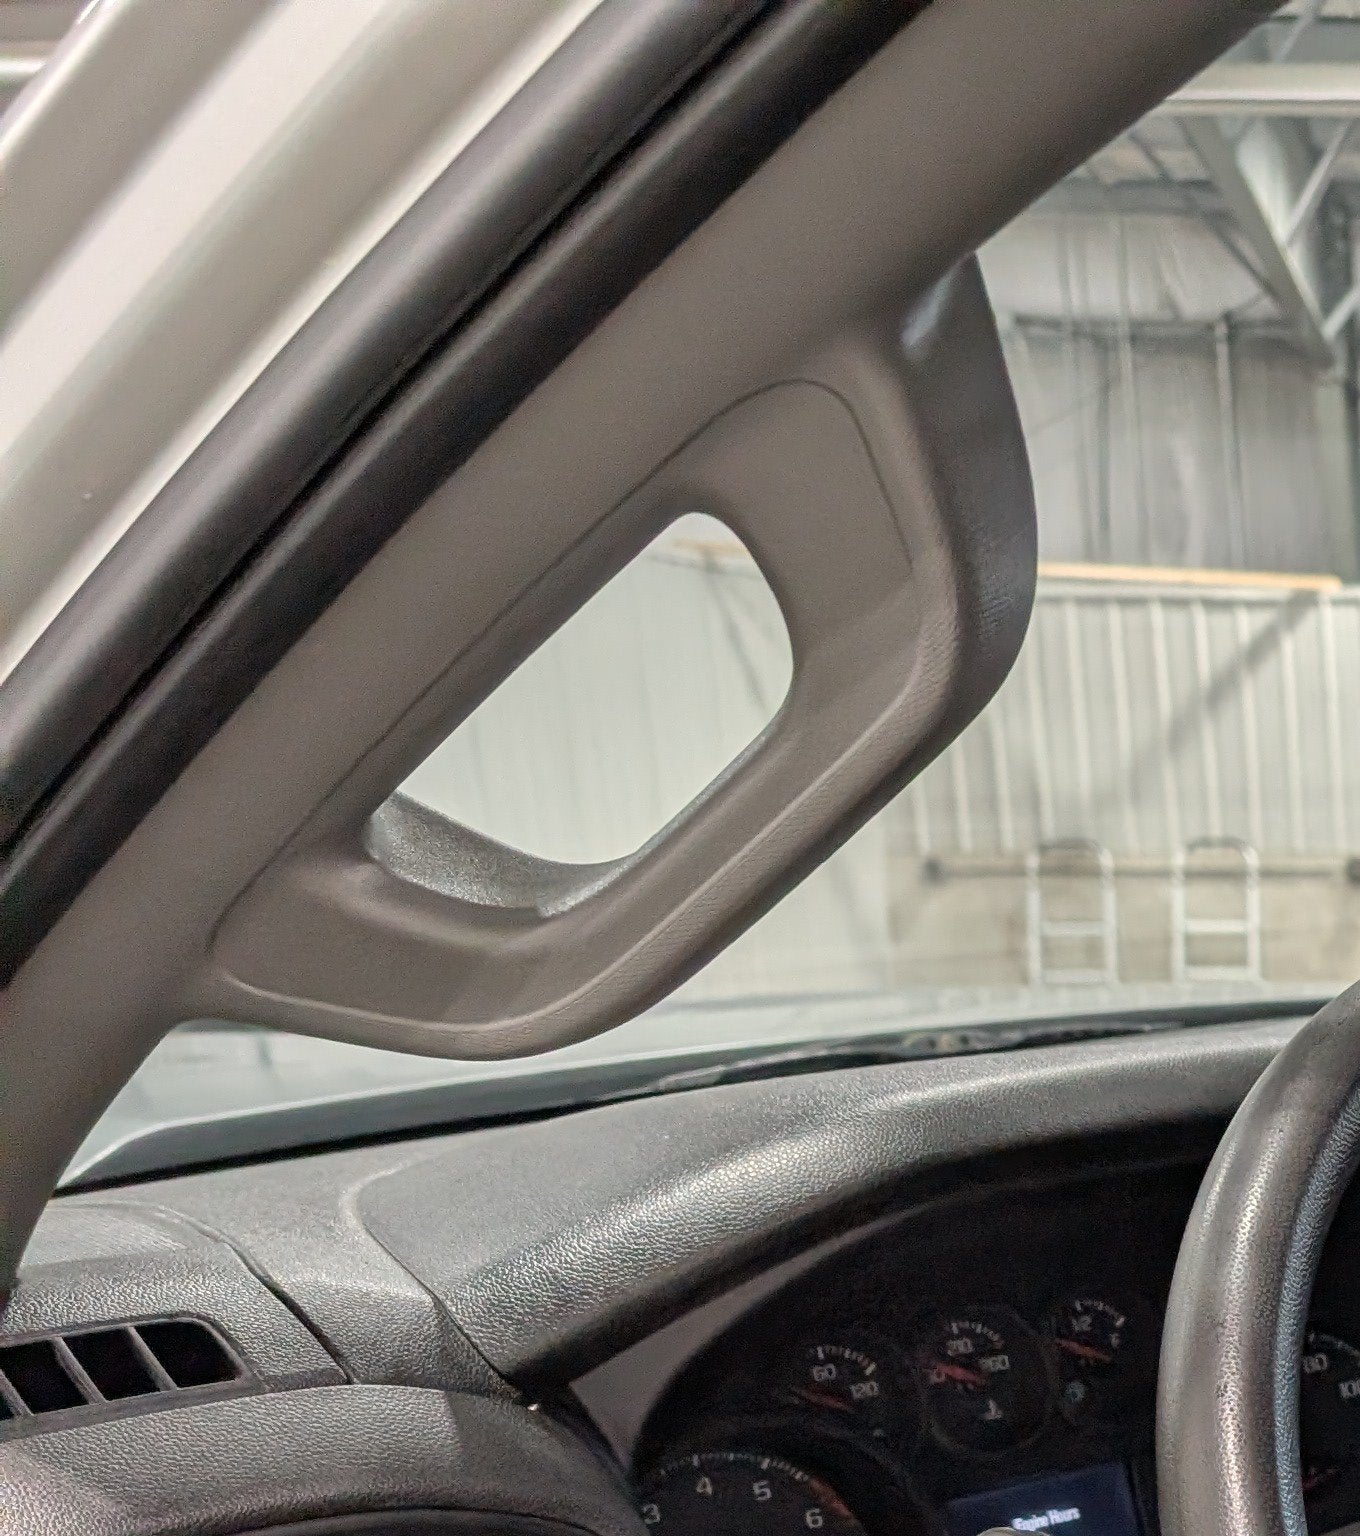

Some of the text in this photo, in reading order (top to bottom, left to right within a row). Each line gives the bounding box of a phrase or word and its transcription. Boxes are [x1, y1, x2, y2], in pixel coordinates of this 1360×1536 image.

[696, 1477, 713, 1496] 4
[753, 1480, 771, 1501] 5
[642, 1503, 661, 1524] 3
[805, 1508, 823, 1529] 6
